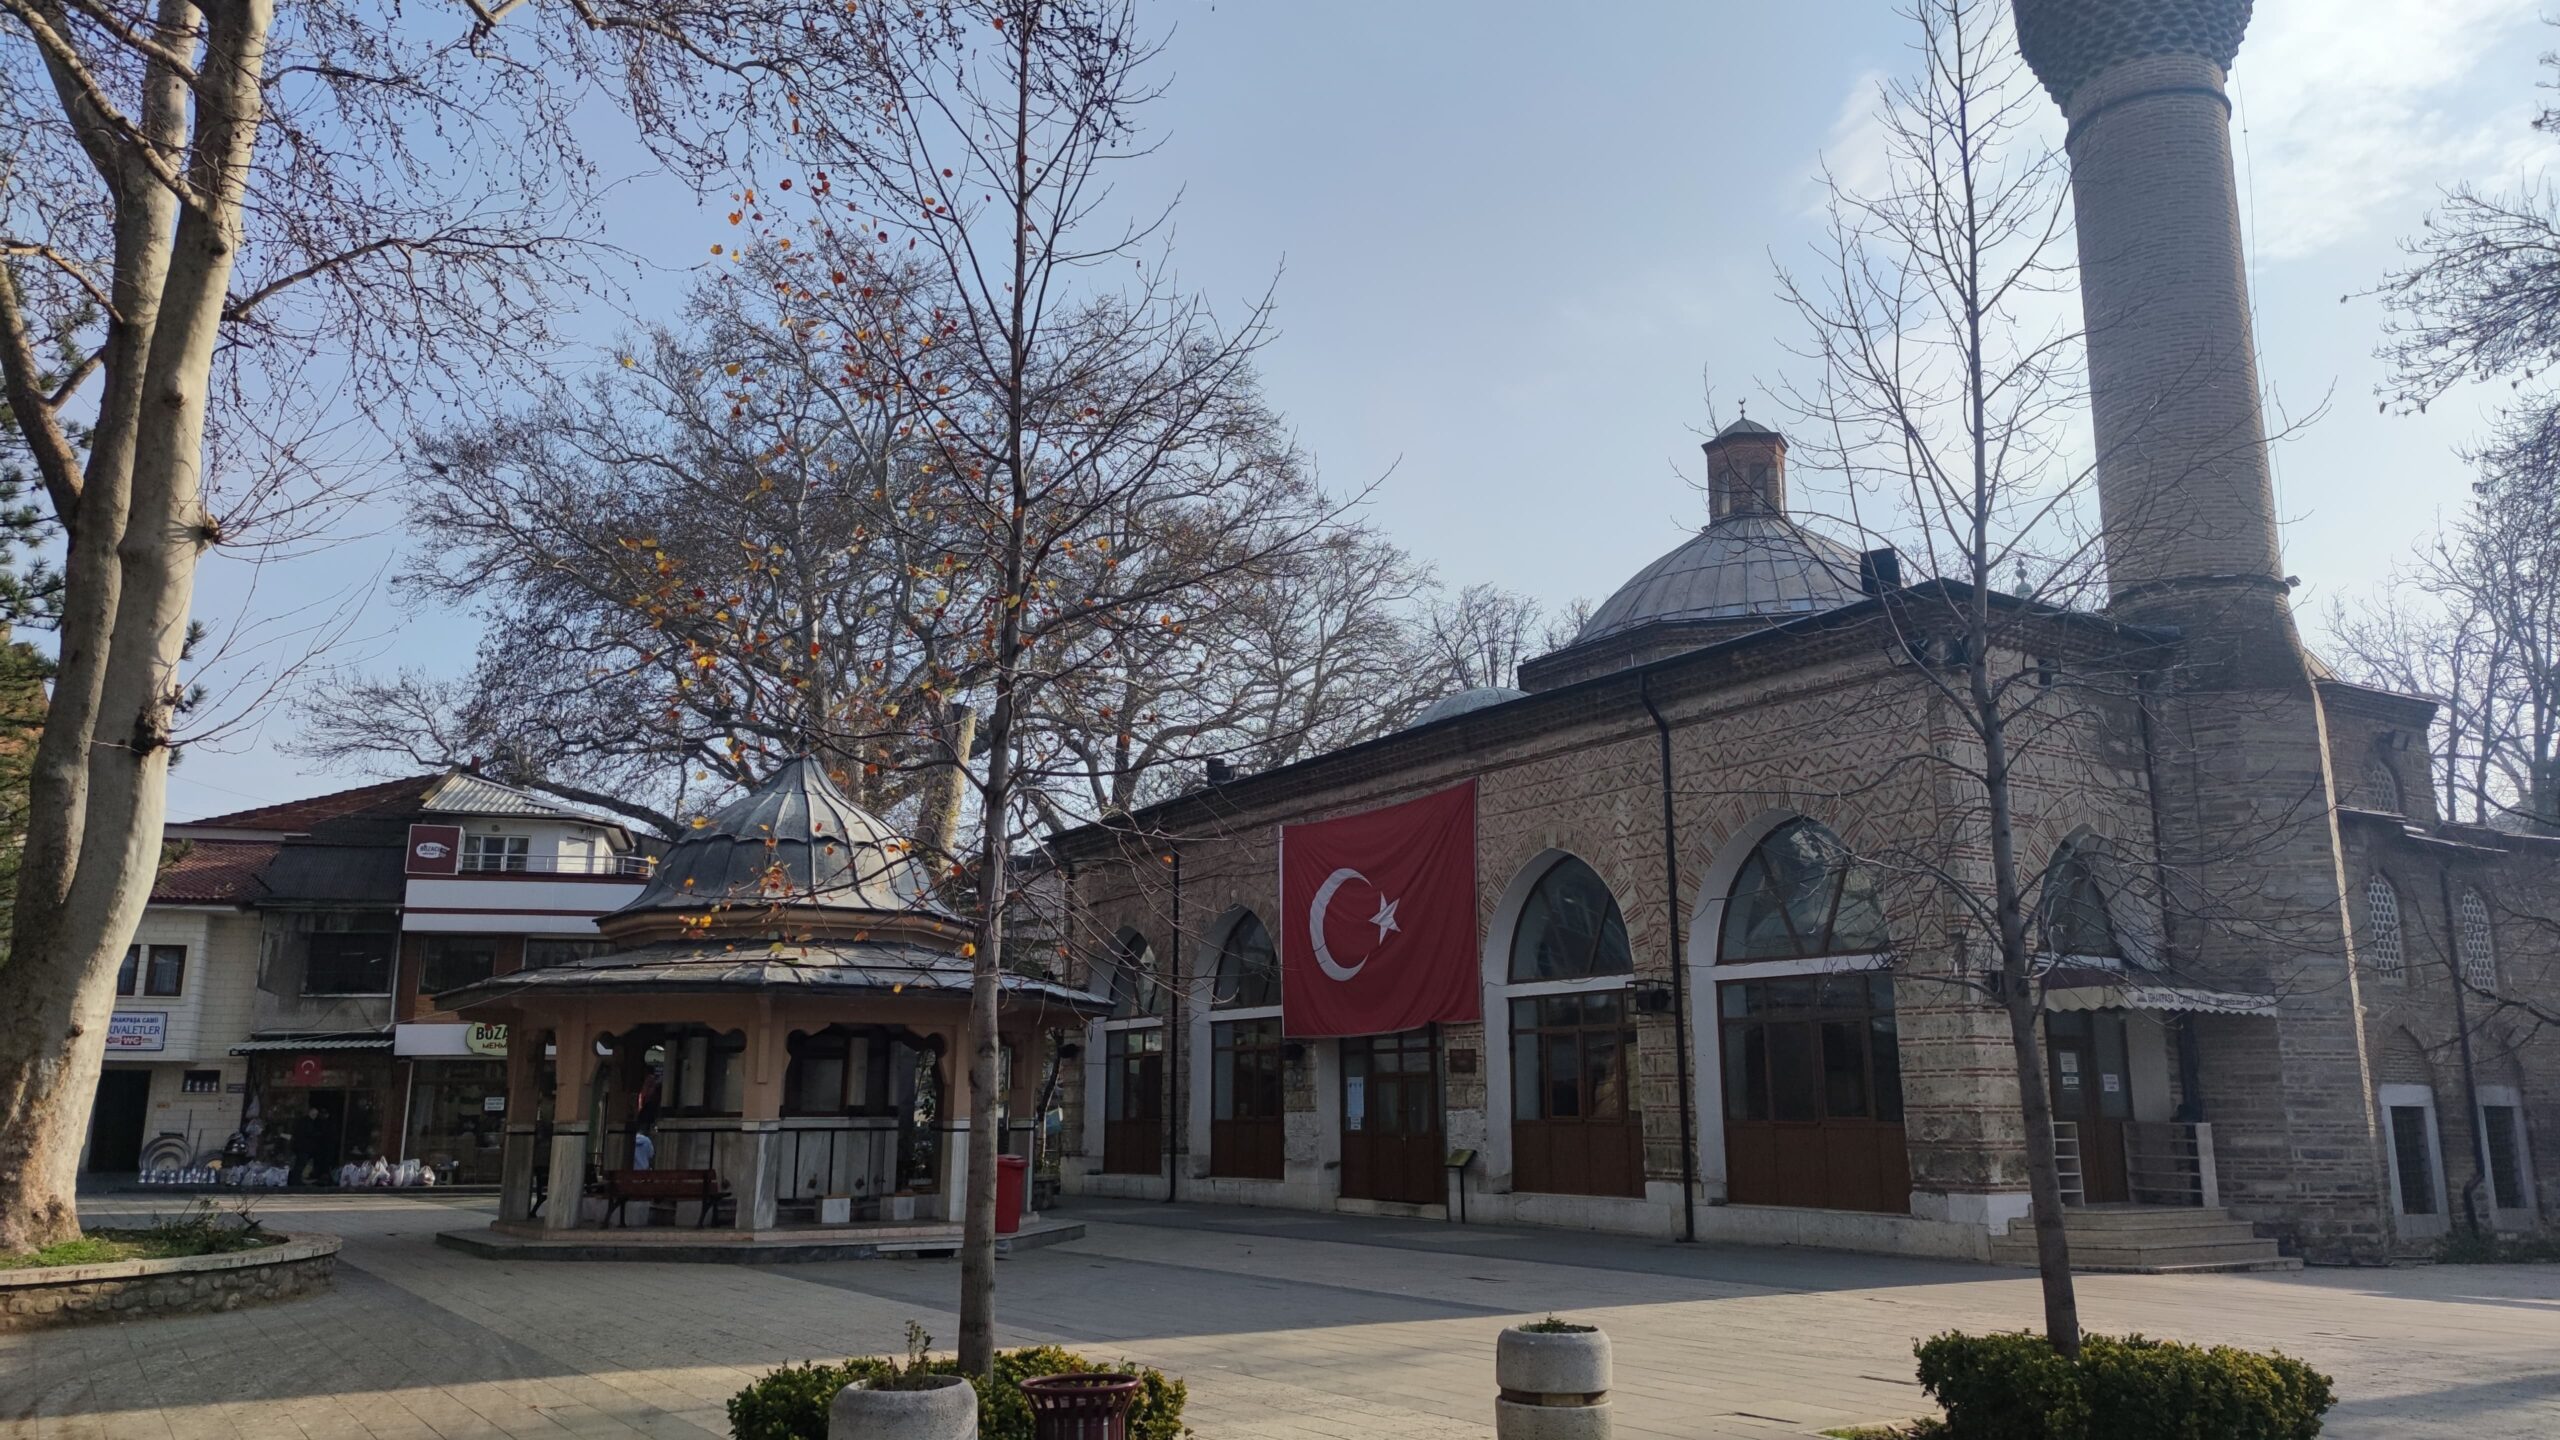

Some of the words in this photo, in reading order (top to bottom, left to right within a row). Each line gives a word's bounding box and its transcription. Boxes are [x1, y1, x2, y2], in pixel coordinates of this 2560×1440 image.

[109, 1025, 160, 1035] UVALETLER
[476, 1026, 510, 1040] BOZA
[123, 1037, 140, 1045] WC
